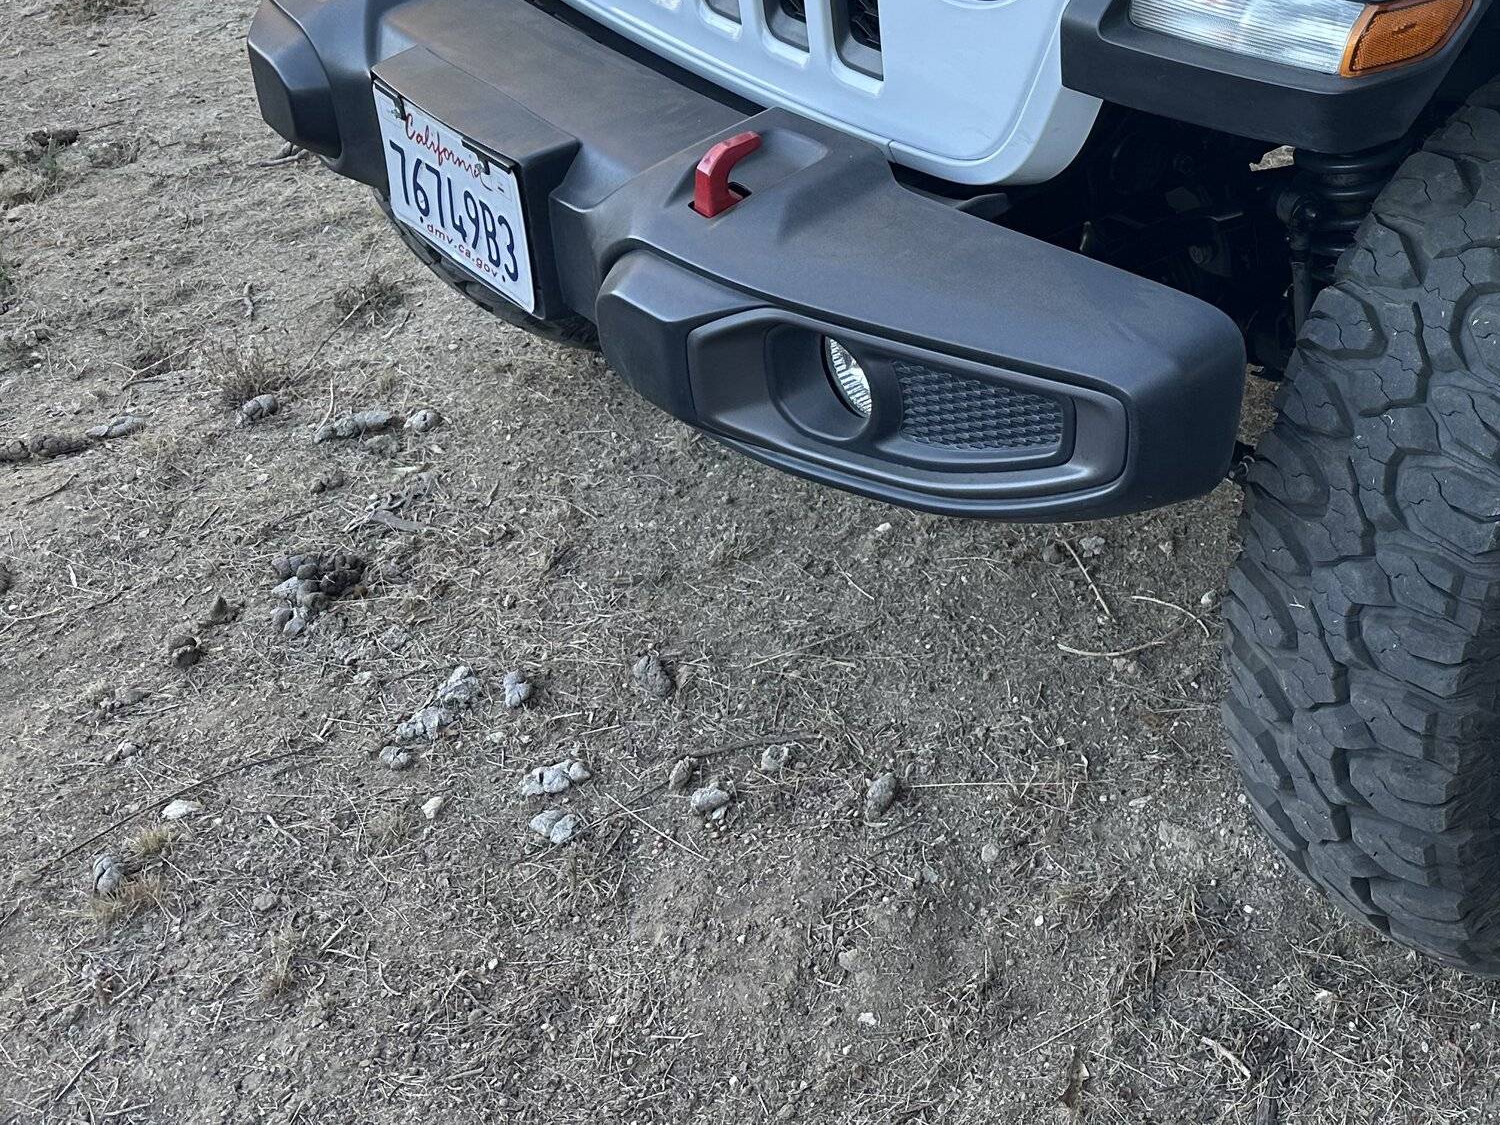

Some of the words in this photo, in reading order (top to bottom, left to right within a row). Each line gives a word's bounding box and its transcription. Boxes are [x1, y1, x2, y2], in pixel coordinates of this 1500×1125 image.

[404, 112, 481, 179] California
[389, 139, 519, 283] 76749B3
[426, 223, 498, 278] dmv.ca.gov
